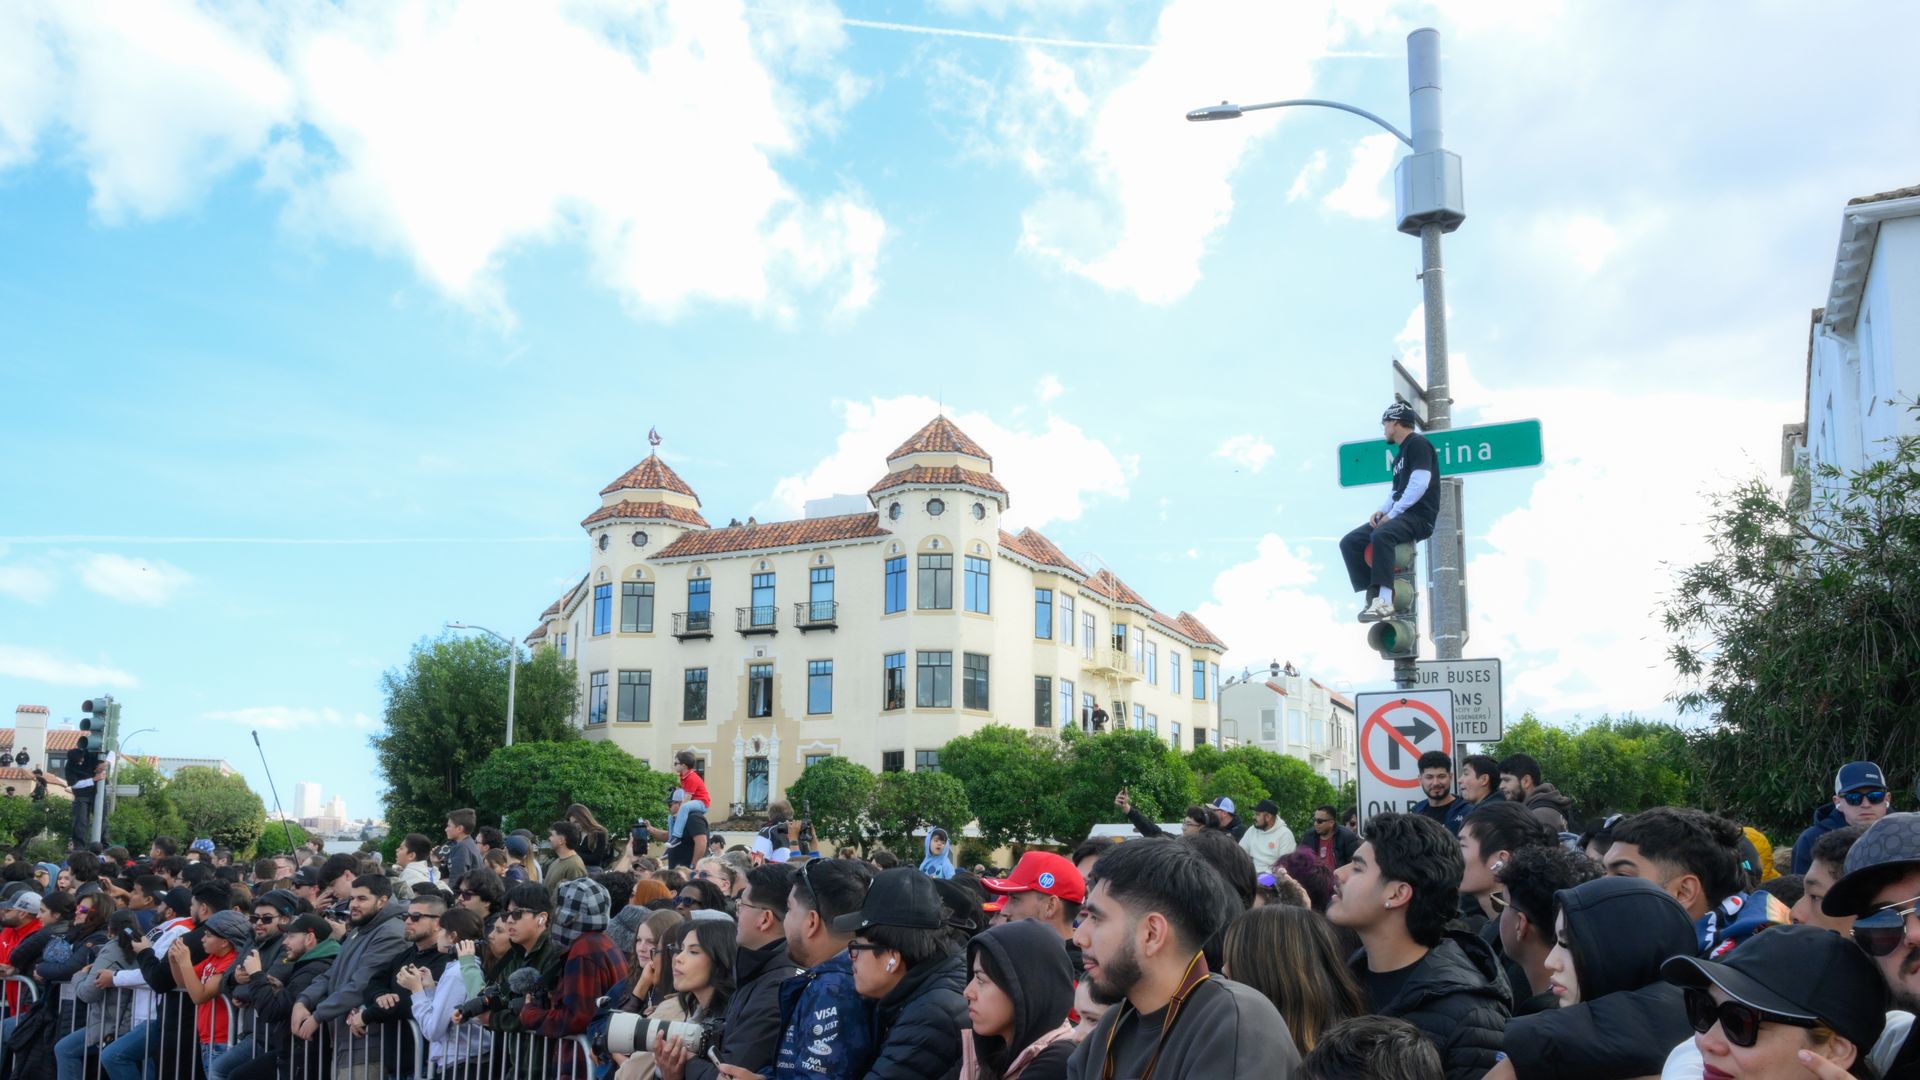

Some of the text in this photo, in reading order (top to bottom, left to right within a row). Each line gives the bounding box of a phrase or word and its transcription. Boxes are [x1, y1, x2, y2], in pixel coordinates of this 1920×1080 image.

[1447, 669, 1491, 683] BUSES
[1041, 873, 1053, 888] hp
[814, 1006, 838, 1020] VISA
[824, 1020, 839, 1032] AT&T
[801, 1061, 828, 1074] TRADE
